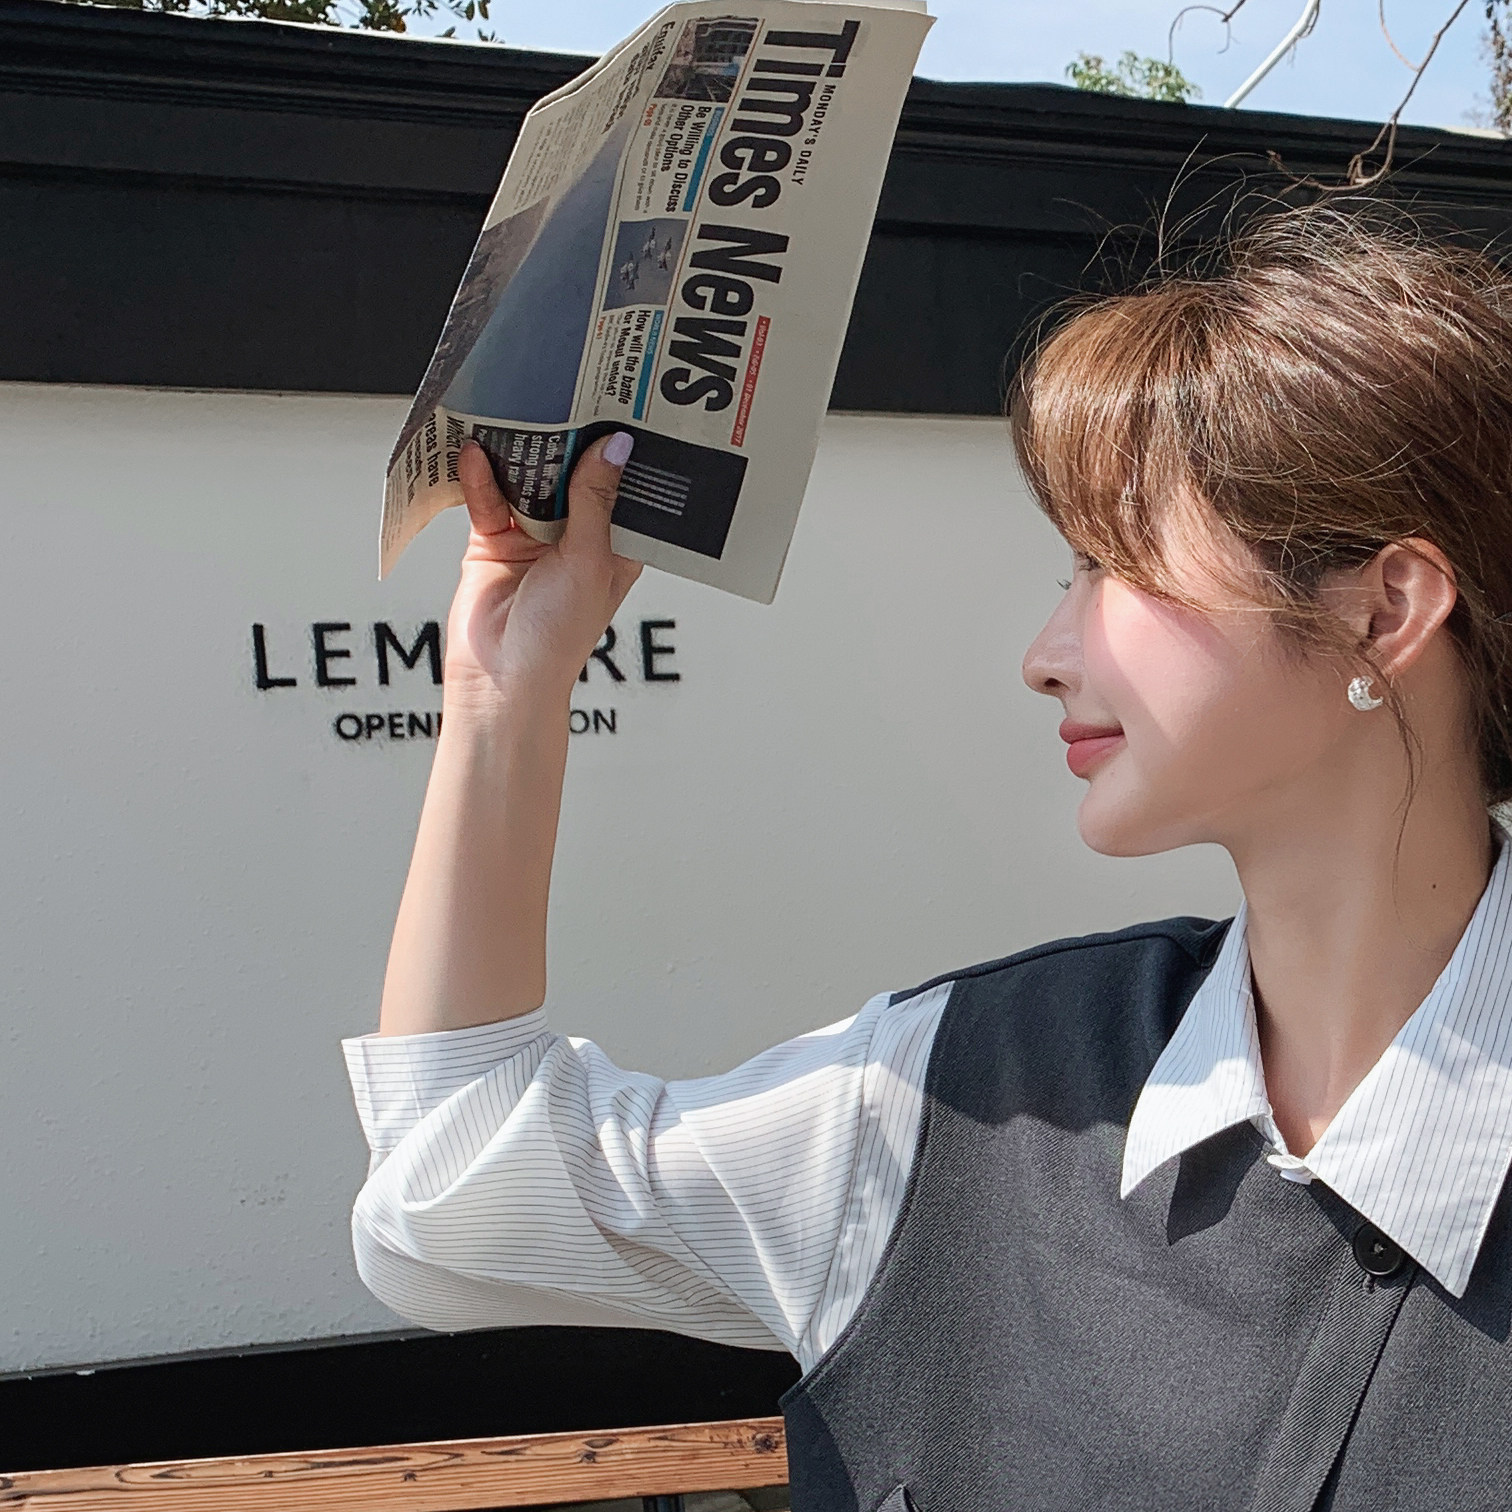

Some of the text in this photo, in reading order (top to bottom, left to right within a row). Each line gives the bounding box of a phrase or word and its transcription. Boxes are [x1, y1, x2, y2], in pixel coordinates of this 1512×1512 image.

[661, 104, 695, 172] Other Options
[791, 84, 837, 186] MONDAY'S DAILY
[665, 106, 712, 213] Be Willing to Discuss
[660, 20, 860, 412] Times News
[624, 310, 635, 325] for
[615, 327, 631, 358] Mosul
[618, 310, 652, 405] How will the battle
[605, 361, 621, 397] unfold?
[508, 433, 528, 484] heavy rain
[524, 434, 544, 466] strong
[545, 434, 561, 462] Cuba
[427, 452, 440, 487] have
[521, 468, 537, 497] winds
[537, 477, 552, 500] with
